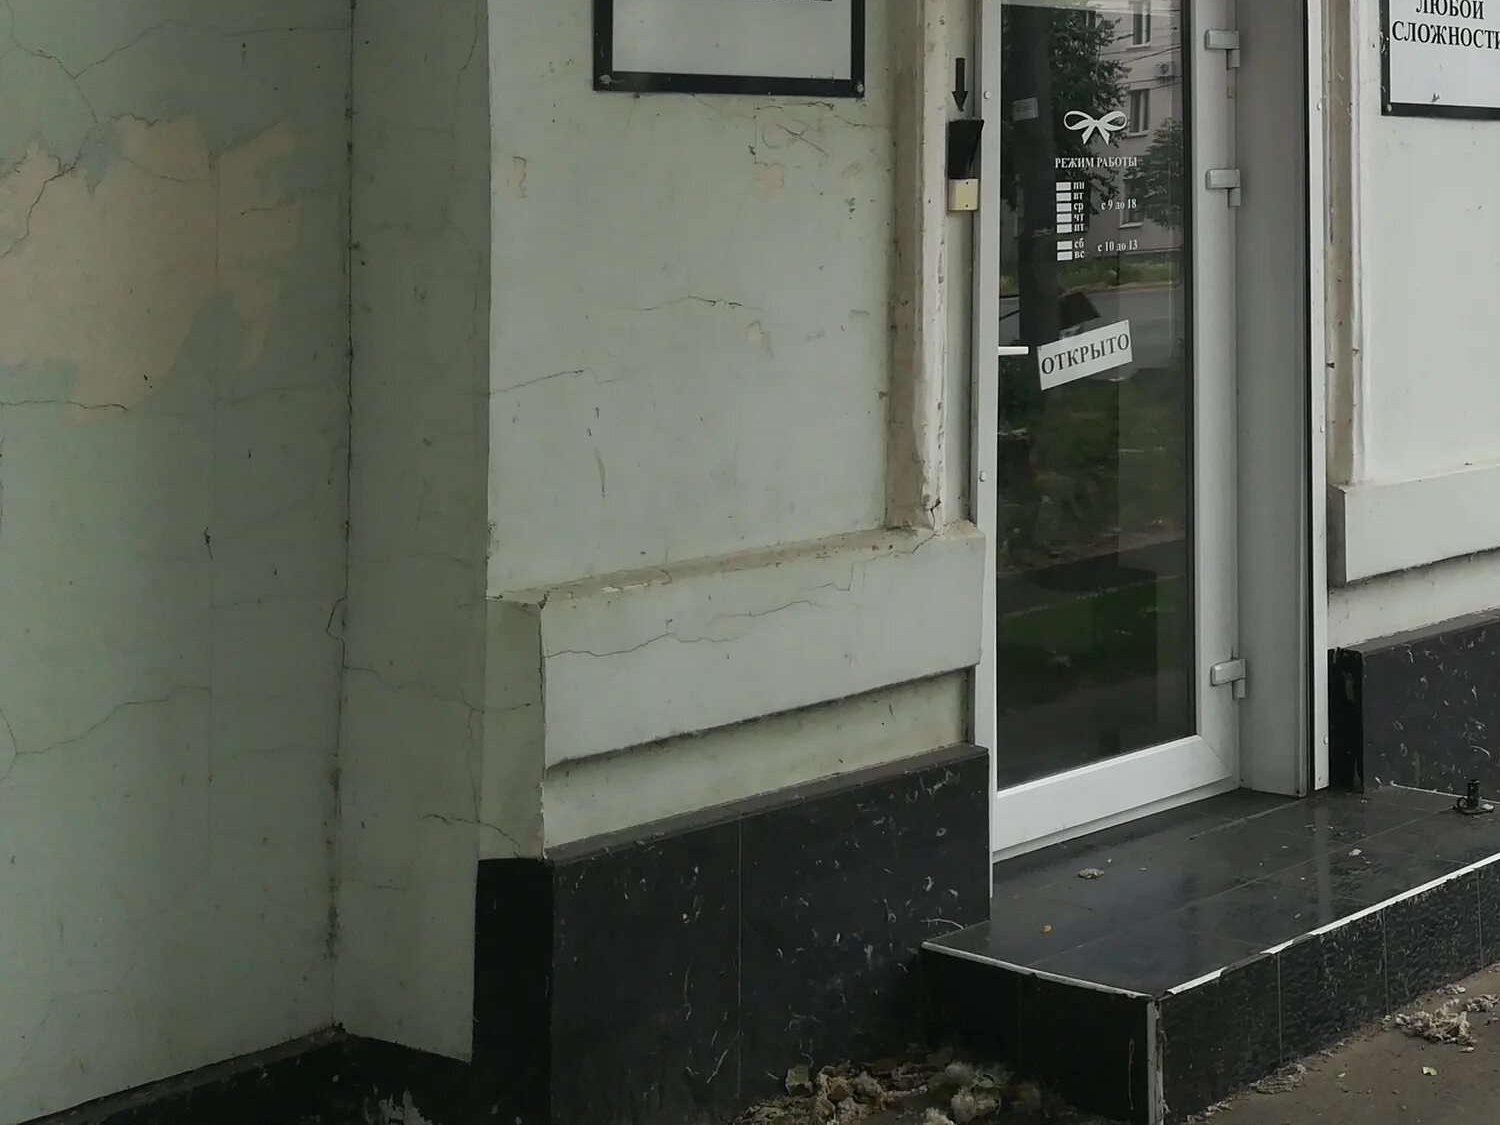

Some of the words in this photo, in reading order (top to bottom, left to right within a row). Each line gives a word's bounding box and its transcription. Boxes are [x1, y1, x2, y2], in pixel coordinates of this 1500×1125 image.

[1055, 157, 1094, 169] РЕЖИМ
[1097, 156, 1138, 168] РАБОТЫ
[1073, 202, 1084, 213] ср
[1101, 202, 1106, 210] с
[1107, 199, 1113, 210] 9
[1114, 202, 1125, 211] до
[1127, 198, 1137, 209] 18
[1074, 237, 1085, 249] сб
[1097, 244, 1103, 252] с
[1105, 240, 1115, 252] 10
[1116, 243, 1126, 252] до
[1128, 239, 1138, 250] 13
[1074, 250, 1085, 259] вс
[1041, 333, 1130, 375] ОТКРЫТО
